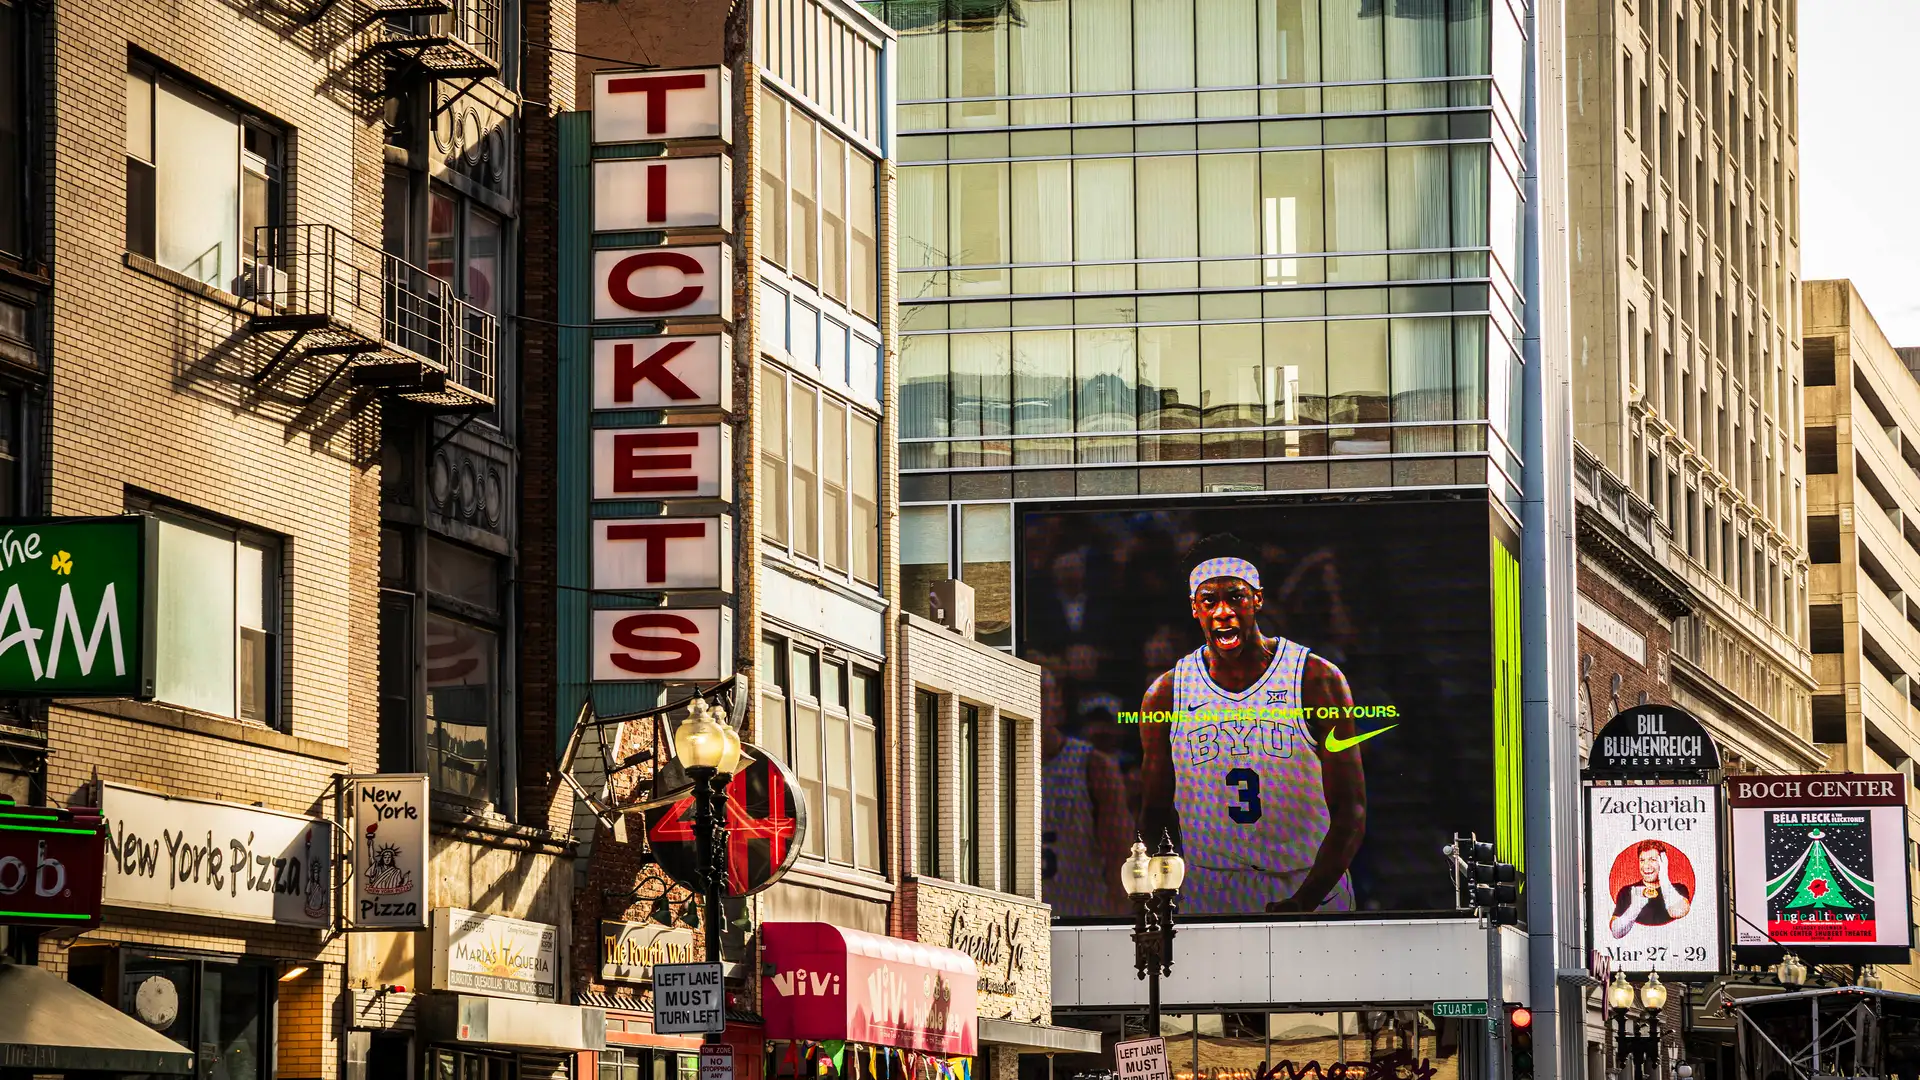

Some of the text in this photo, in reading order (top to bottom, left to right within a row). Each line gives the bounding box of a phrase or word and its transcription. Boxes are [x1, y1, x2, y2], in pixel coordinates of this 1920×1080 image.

[607, 74, 705, 674] TICKETS
[1117, 711, 1139, 724] I'M
[1195, 709, 1218, 722] ON
[1262, 707, 1313, 720] COURT
[1317, 707, 1340, 719] OR
[1342, 705, 1400, 719] YOURS.
[1637, 714, 1667, 735] BILL
[1187, 720, 1295, 765] BYU
[1604, 736, 1702, 757] BLUMENREICH
[1609, 758, 1697, 766] PRESENTS
[362, 787, 401, 802] New
[1226, 768, 1262, 824] 3
[1738, 781, 1897, 799] BOCH CENTER
[373, 802, 417, 821] York
[1600, 796, 1706, 814] Zachariah
[1631, 815, 1697, 831] Porter
[1773, 812, 1830, 824] BÉLA FLECK
[105, 818, 300, 897] New York Pizza
[361, 897, 416, 919] Pizza
[1775, 910, 1807, 924] jingle
[1824, 910, 1843, 921] the
[456, 942, 496, 964] MARIA'S
[503, 948, 549, 972] TAQUERIA
[605, 934, 692, 967] The Fourth Wall
[1606, 947, 1643, 961] Mar
[1646, 947, 1668, 961] 27
[1685, 947, 1706, 961] 29
[474, 975, 503, 990] QUESADILLAS
[504, 979, 518, 992] TACOS
[520, 982, 537, 995] NACHOS
[658, 971, 718, 986] LEFT LANE
[665, 990, 711, 1006] MUST
[660, 1010, 720, 1024] TURN LEFT
[1437, 1004, 1472, 1014] STUART
[1120, 1044, 1162, 1059] LEFT LANE
[1126, 1058, 1158, 1073] MUST
